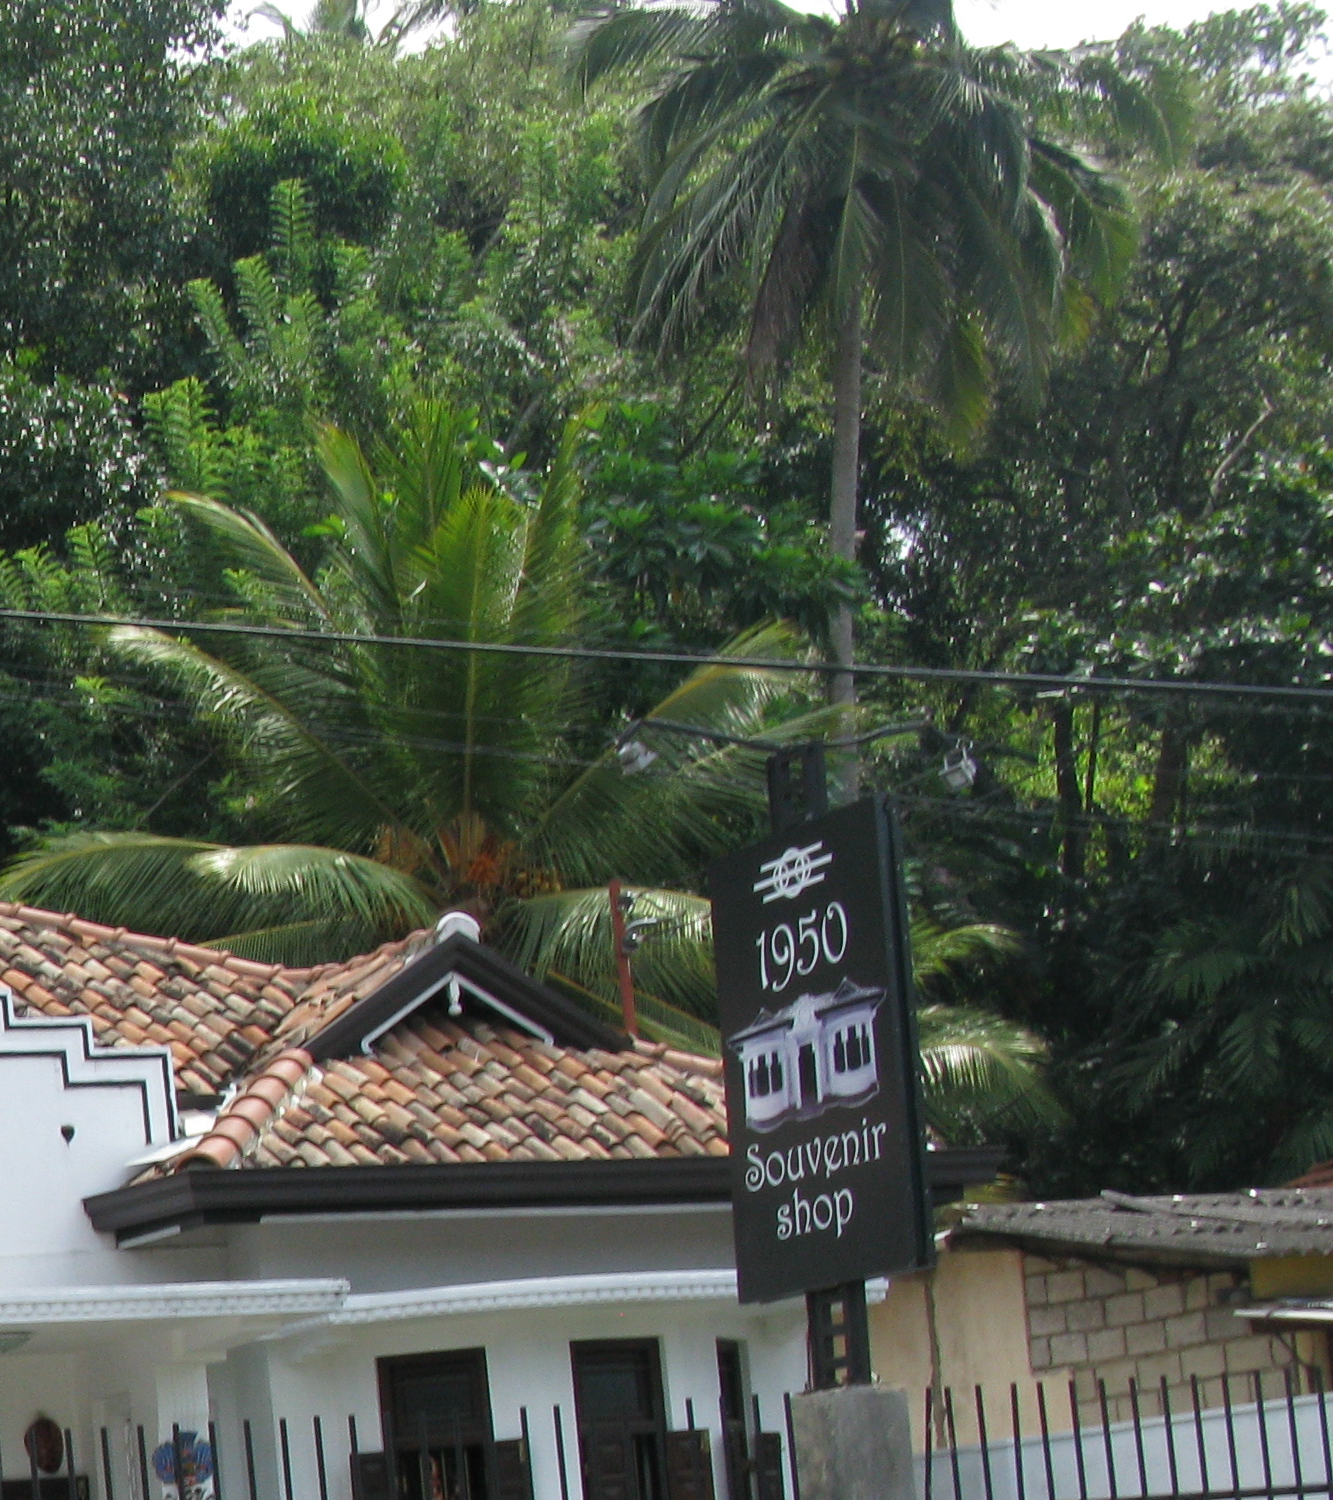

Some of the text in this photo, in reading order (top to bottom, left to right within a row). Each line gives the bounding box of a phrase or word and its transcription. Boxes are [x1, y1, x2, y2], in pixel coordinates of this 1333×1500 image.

[756, 901, 849, 993] 1950
[745, 1117, 887, 1194] Souvenir
[776, 1186, 855, 1241] shop
